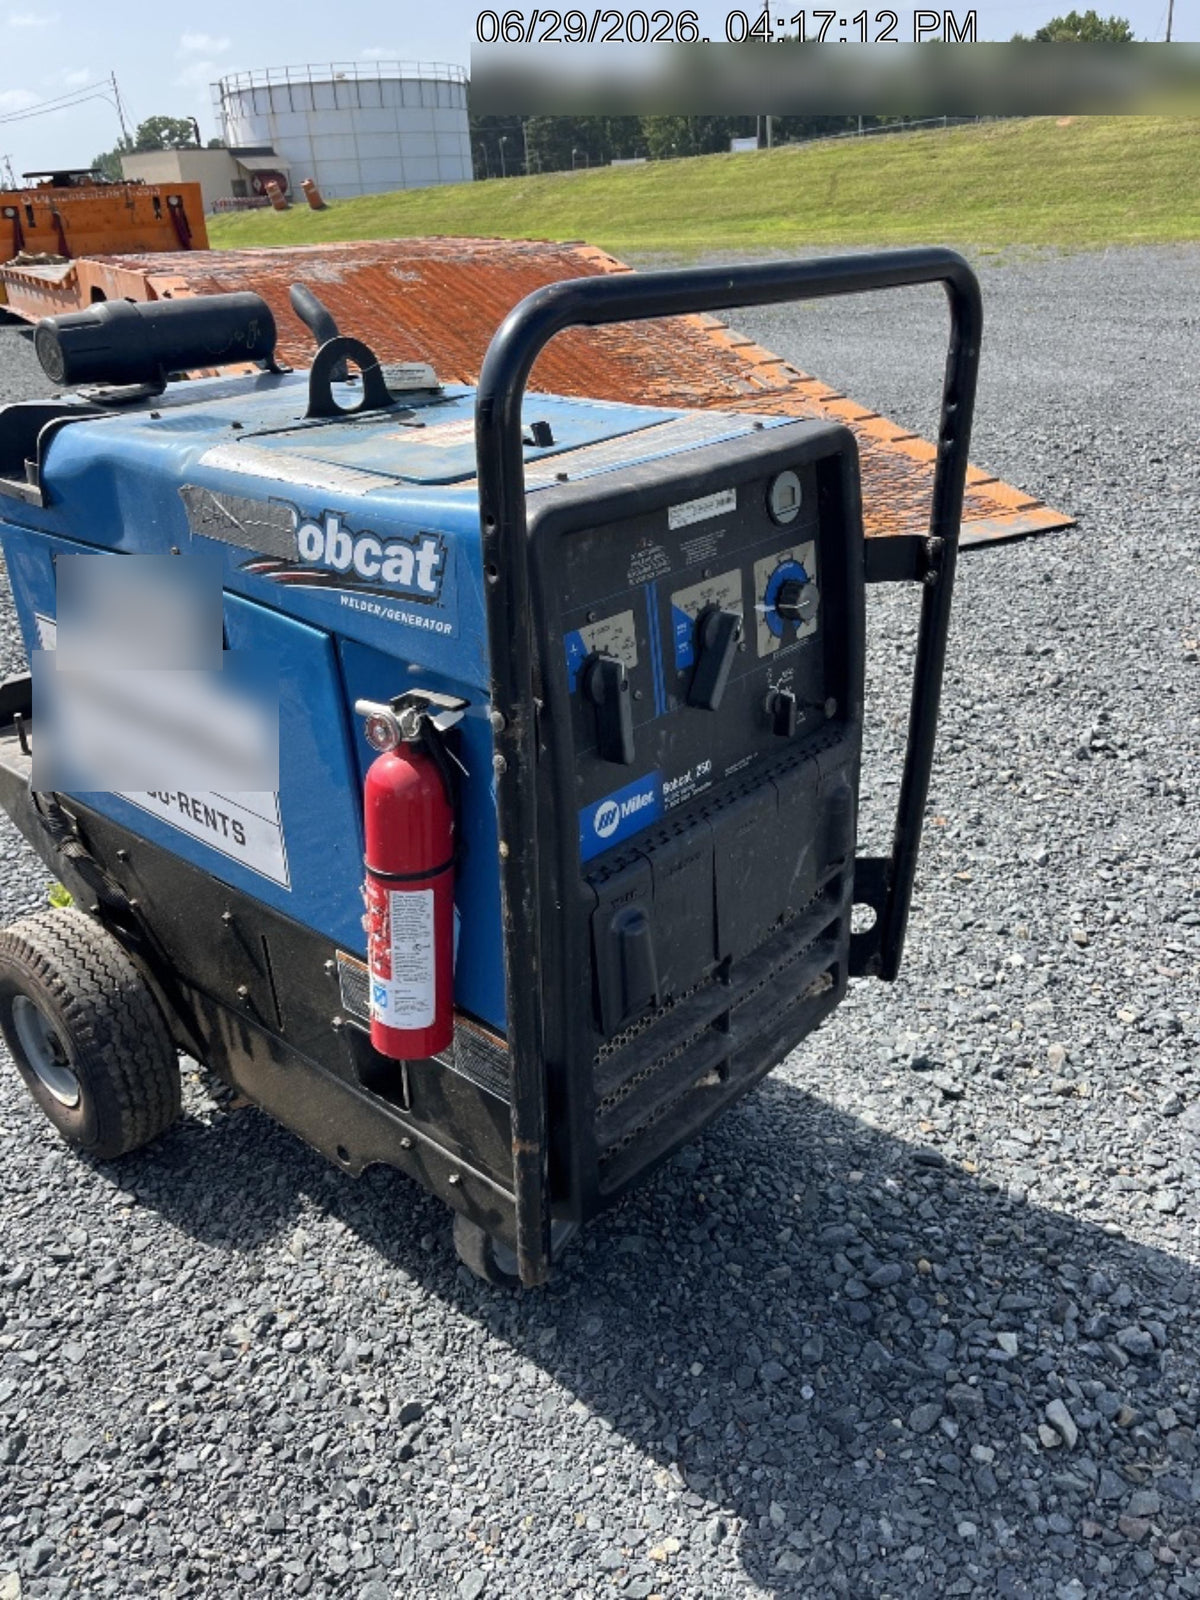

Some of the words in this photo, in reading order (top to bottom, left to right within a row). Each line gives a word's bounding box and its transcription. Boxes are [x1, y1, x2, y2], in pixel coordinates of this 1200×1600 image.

[290, 508, 440, 593] obcat
[339, 594, 453, 635] WELDER/GENERATOR
[146, 791, 247, 846] -RENTS
[621, 790, 655, 819] Miller
